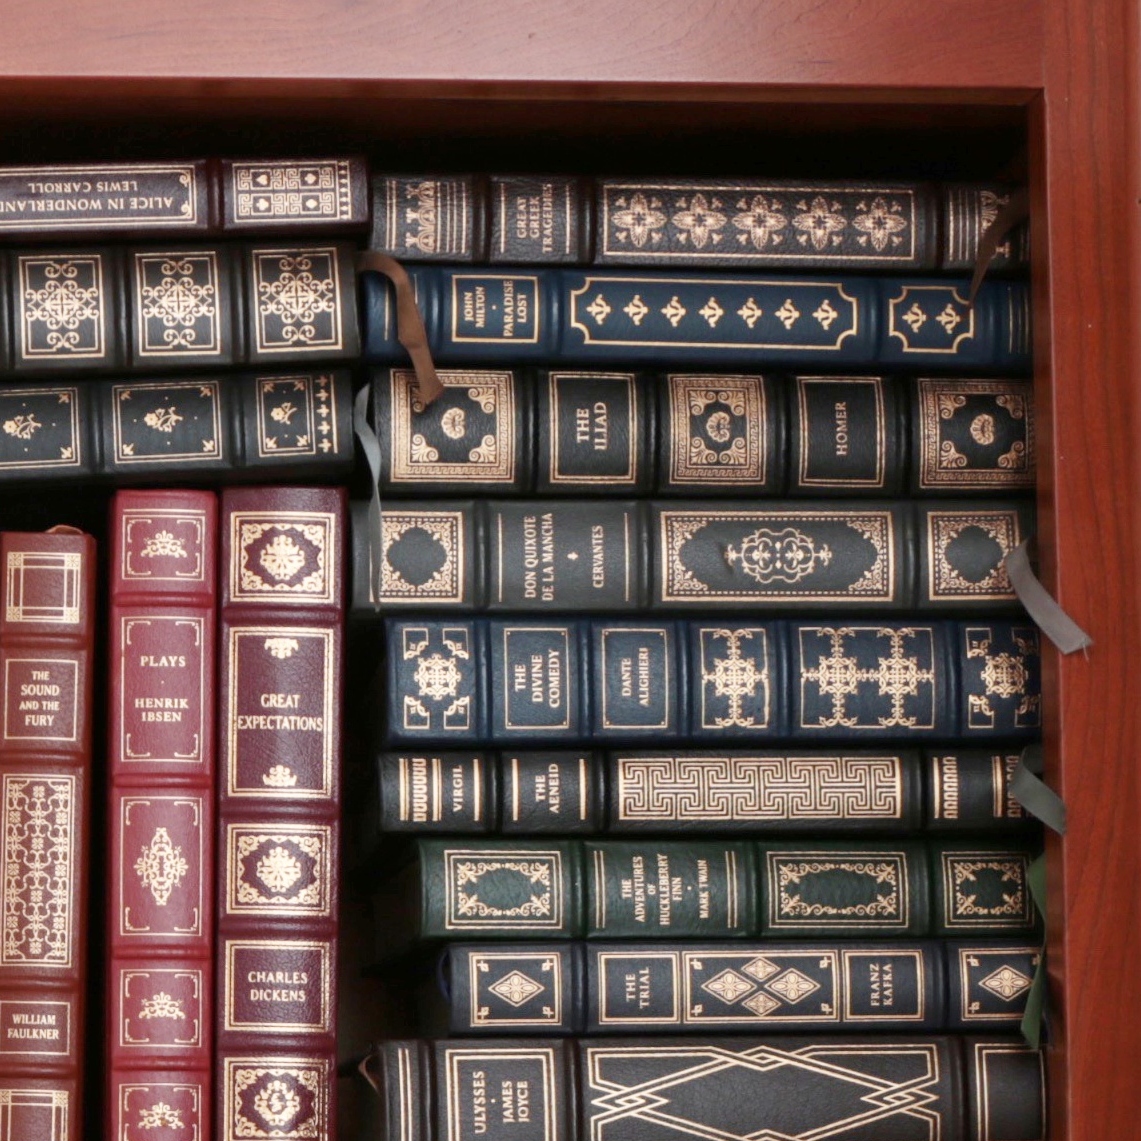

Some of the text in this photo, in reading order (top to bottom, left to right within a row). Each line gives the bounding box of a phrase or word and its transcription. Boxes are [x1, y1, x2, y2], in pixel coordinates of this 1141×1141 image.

[28, 180, 138, 193] LEWIS CARROLL
[107, 198, 126, 210] IN
[130, 197, 173, 209] ALICE
[576, 408, 590, 443] THE
[594, 402, 607, 450] ILIAD
[836, 402, 847, 456] HOMER
[523, 516, 537, 598] DON QUIXOTE
[541, 513, 553, 601] DE LA MANCHA
[593, 525, 603, 588] CERVANTES
[32, 671, 50, 680] THE
[140, 655, 186, 667] PLAYS
[21, 683, 60, 695] SOUND
[515, 663, 526, 692] THE
[531, 654, 542, 702] DIVINE
[548, 650, 560, 708] COMEDY
[621, 658, 632, 697] DANTE
[639, 647, 649, 706] ALIGHIERI
[19, 700, 60, 710] AND THE
[134, 698, 189, 709] HENRIK
[260, 694, 300, 708] GREAT
[24, 714, 55, 726] FURY
[141, 711, 182, 722] IBSEN
[237, 715, 323, 731] EXPECTATIONS
[453, 765, 463, 812] VIRGIL
[535, 774, 546, 802] THE
[549, 763, 559, 813] AENEID
[248, 971, 308, 984] CHARLES
[626, 973, 636, 1002] THE
[640, 967, 650, 1008] TRIAL
[871, 963, 880, 1007] FRANZ
[883, 964, 893, 1005] KAFKA
[250, 988, 306, 1001] DICKENS
[7, 1027, 59, 1040] FAULKNER
[12, 1013, 56, 1025] WILLIAM
[474, 1071, 487, 1134] ULYSSES
[503, 1080, 513, 1123] JAMES
[518, 1081, 529, 1122] JOYCE
